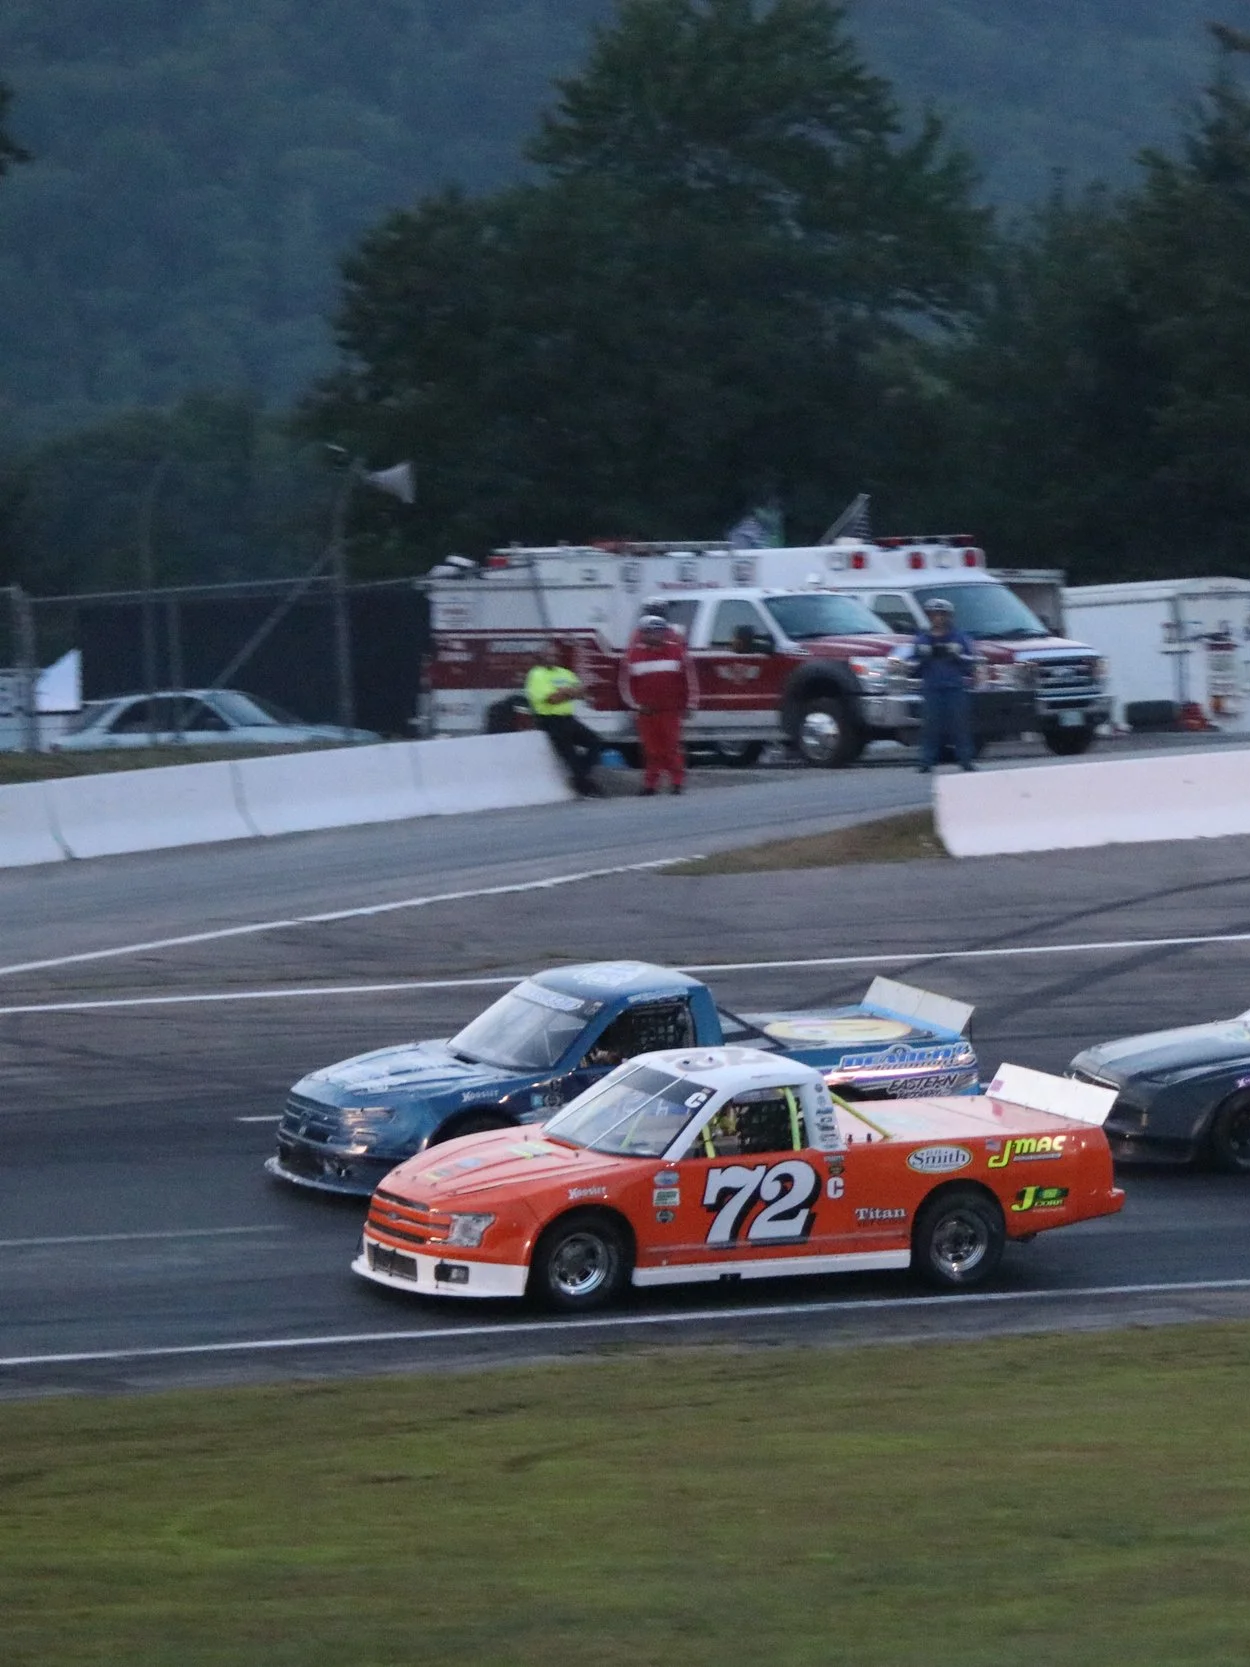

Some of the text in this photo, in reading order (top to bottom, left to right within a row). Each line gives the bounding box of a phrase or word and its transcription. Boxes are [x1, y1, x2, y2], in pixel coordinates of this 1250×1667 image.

[888, 1074, 957, 1091] EASTERN
[913, 1148, 966, 1167] Smith
[827, 1177, 845, 1198] C
[702, 1160, 820, 1247] 72
[855, 1207, 907, 1220] Titan
